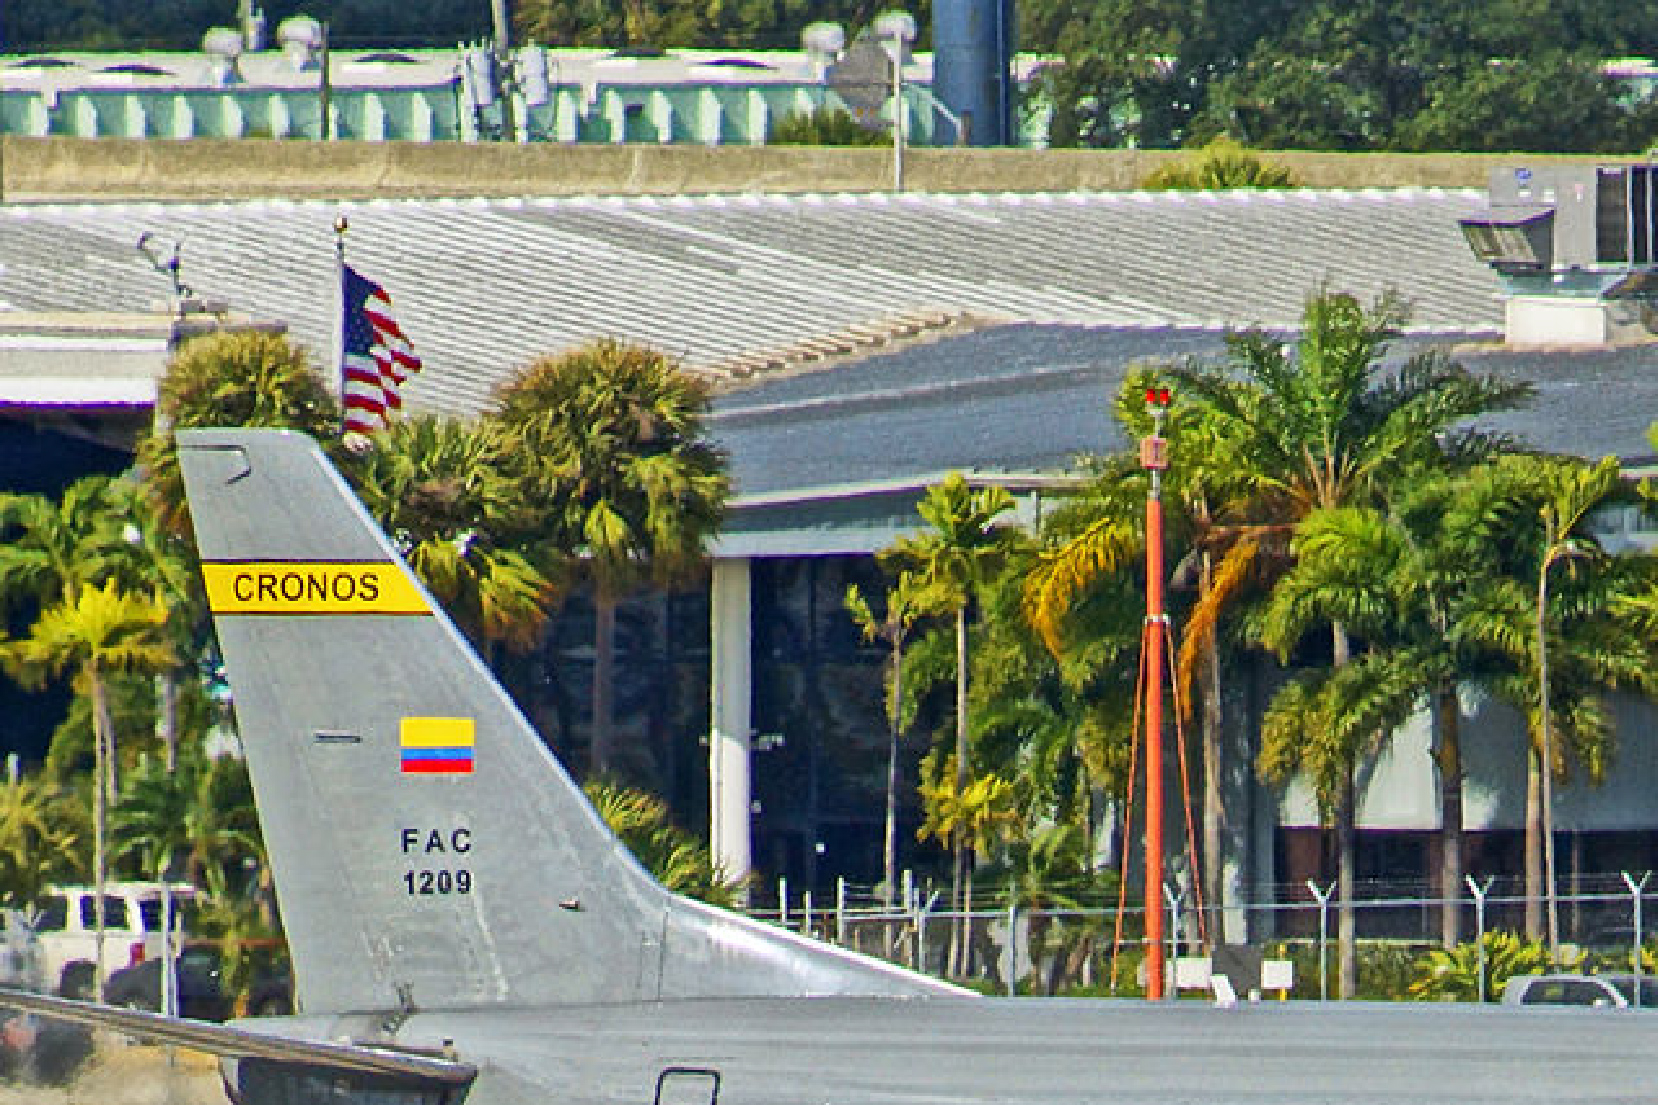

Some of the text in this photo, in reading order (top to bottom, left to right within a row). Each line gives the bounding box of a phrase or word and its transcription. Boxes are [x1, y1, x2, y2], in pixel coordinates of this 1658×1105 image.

[235, 571, 380, 603] CRONOS
[400, 828, 472, 854] FAC
[403, 869, 472, 896] 1209
